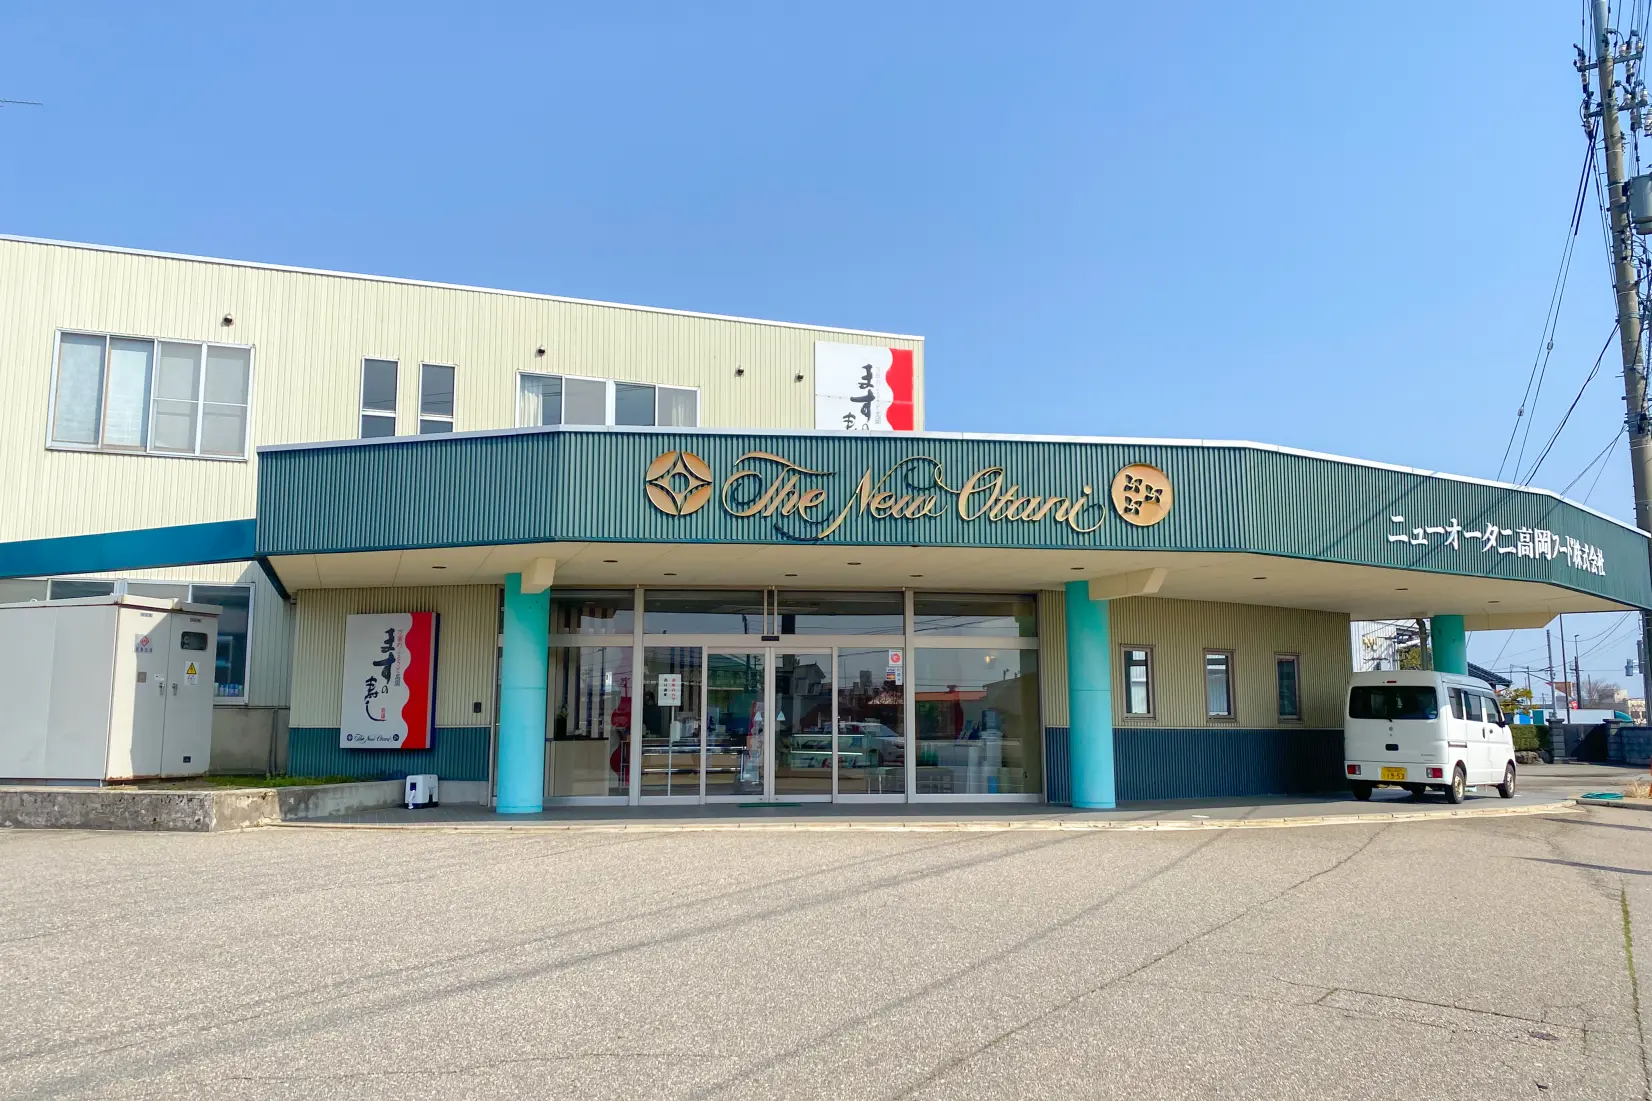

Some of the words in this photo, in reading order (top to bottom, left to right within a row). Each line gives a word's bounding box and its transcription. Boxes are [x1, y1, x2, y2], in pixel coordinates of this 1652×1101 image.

[723, 451, 836, 523] The
[773, 456, 948, 540] New
[957, 466, 1106, 533] Otani
[1388, 515, 1606, 576] ニューオータニ高岡フード株式会社
